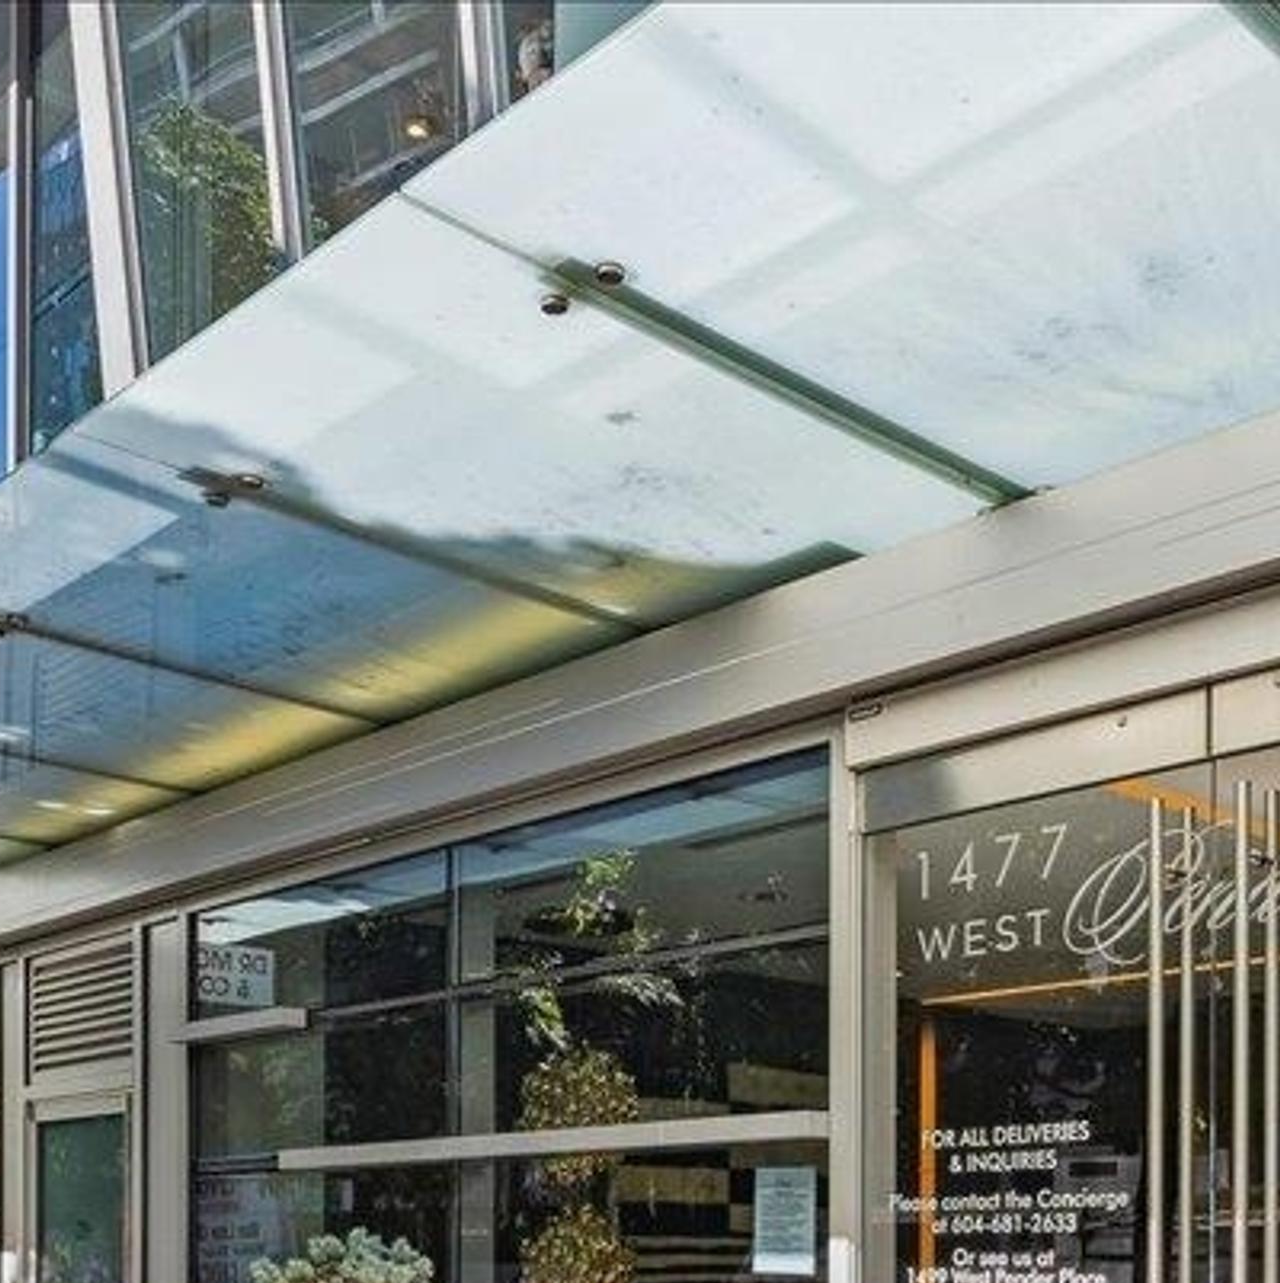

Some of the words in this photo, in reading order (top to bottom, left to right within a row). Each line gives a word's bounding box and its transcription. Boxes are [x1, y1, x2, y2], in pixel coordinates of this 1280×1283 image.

[917, 823, 1068, 900] 1477
[917, 908, 1051, 963] WEST
[922, 1129, 955, 1150] FOR
[960, 1127, 989, 1148] ALL
[993, 1119, 1090, 1146] DELIVERIES
[948, 1155, 963, 1173] &
[966, 1150, 1057, 1173] INQUIRIES
[889, 1193, 938, 1212] Please
[941, 1193, 1000, 1210] contact
[1005, 1190, 1032, 1208] the
[1036, 1187, 1129, 1211] Concierge
[931, 1216, 949, 1233] at
[951, 1212, 1078, 1234] 604-681-2633
[952, 1248, 974, 1266] Or
[979, 1251, 1009, 1267] see
[1012, 1251, 1032, 1266] us
[1036, 1248, 1055, 1266] at
